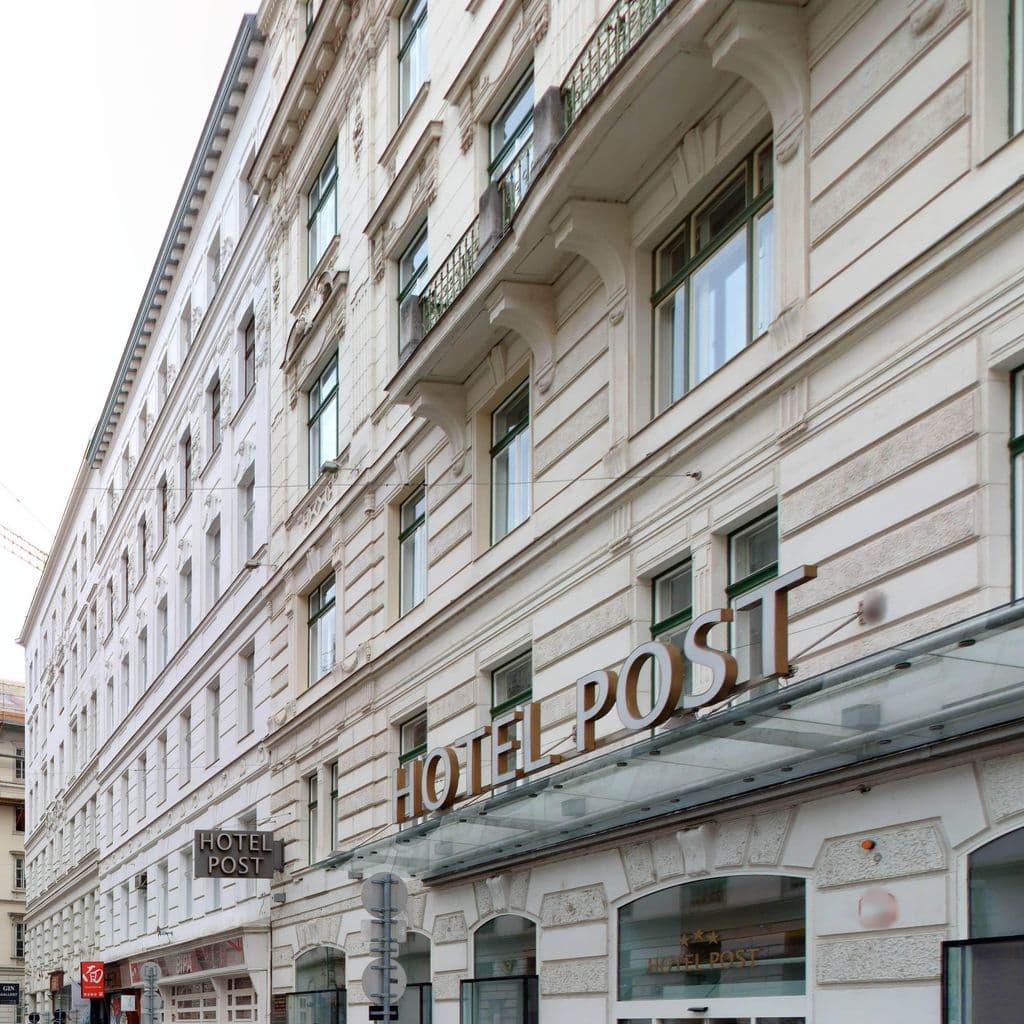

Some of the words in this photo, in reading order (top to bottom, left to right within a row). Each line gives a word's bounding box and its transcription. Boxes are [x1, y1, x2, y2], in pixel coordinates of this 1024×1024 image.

[392, 702, 561, 823] HOTEL
[576, 566, 815, 752] POST
[200, 832, 273, 853] HOTEL
[208, 855, 265, 875] POST
[647, 953, 700, 975] HOTEL
[709, 947, 760, 970] POST
